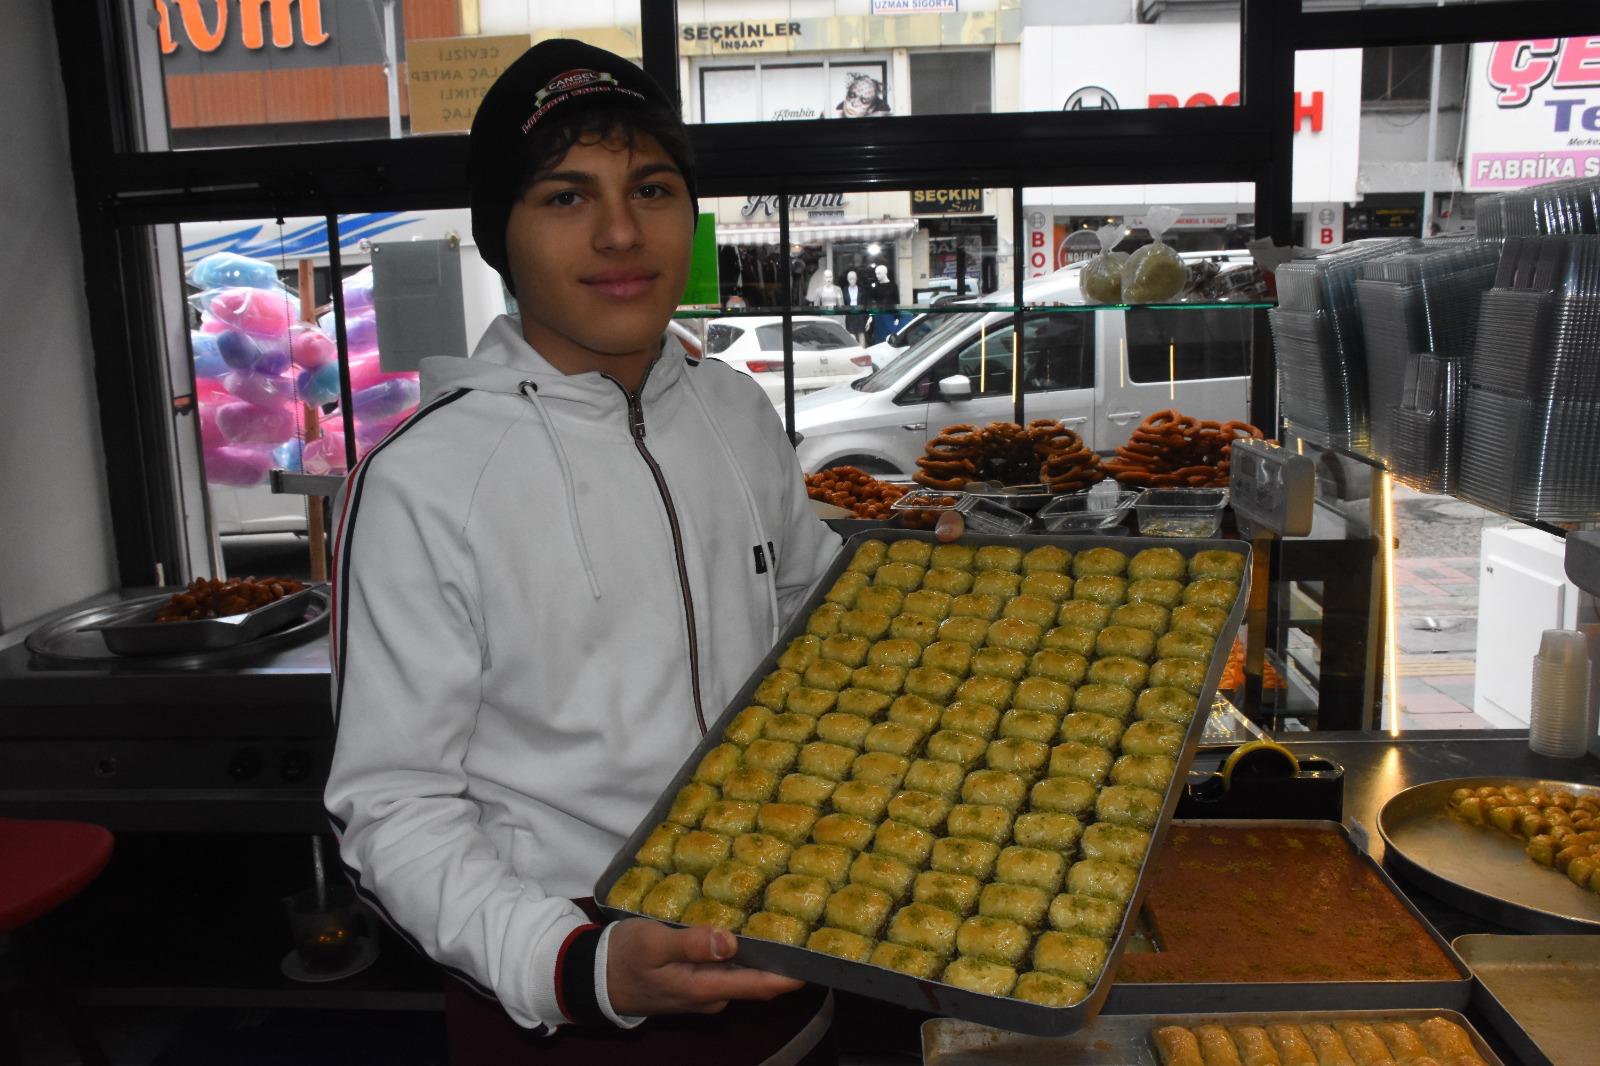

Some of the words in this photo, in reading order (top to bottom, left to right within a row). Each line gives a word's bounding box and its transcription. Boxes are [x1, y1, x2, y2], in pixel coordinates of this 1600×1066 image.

[683, 21, 802, 42] SEÇKİNLER
[720, 39, 765, 50] İNŞAAT
[548, 72, 598, 90] CANSEL
[1476, 153, 1576, 180] FABRİKA
